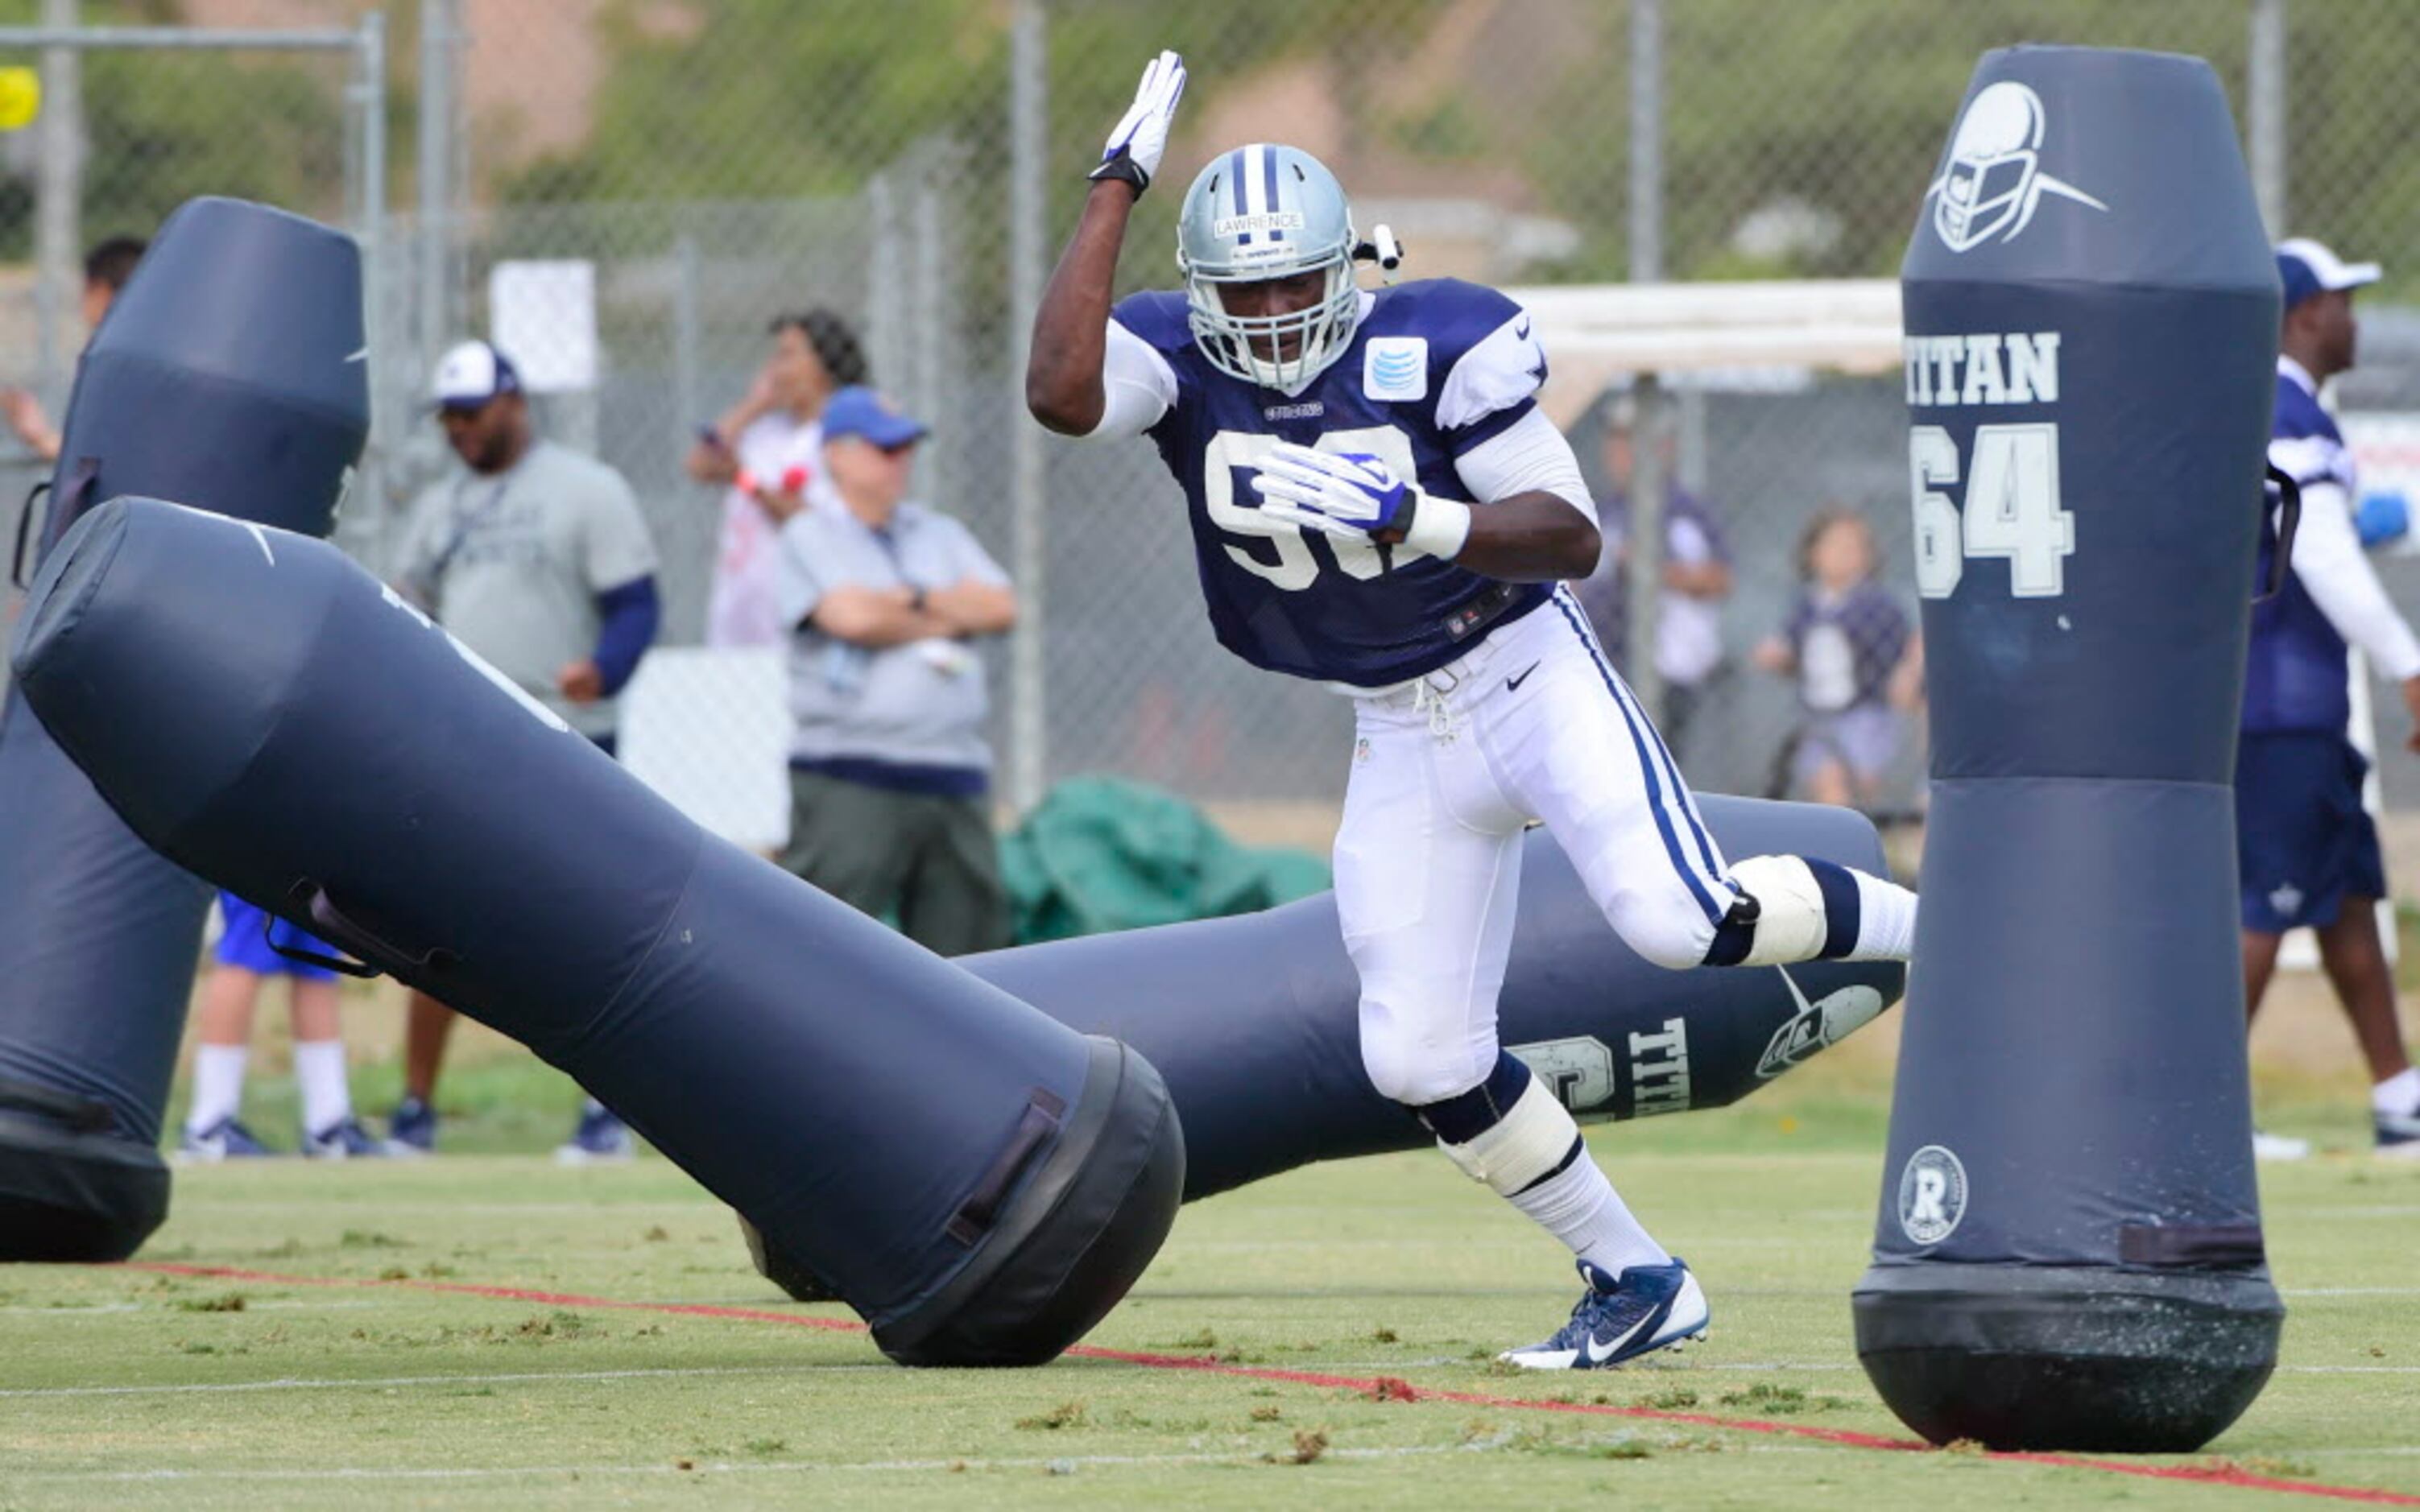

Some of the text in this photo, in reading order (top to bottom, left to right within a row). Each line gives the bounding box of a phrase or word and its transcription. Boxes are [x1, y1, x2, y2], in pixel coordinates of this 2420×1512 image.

[1217, 213, 1301, 234] LAWRENCE
[1909, 423, 2075, 598] 64
[1911, 1168, 1946, 1221] R
